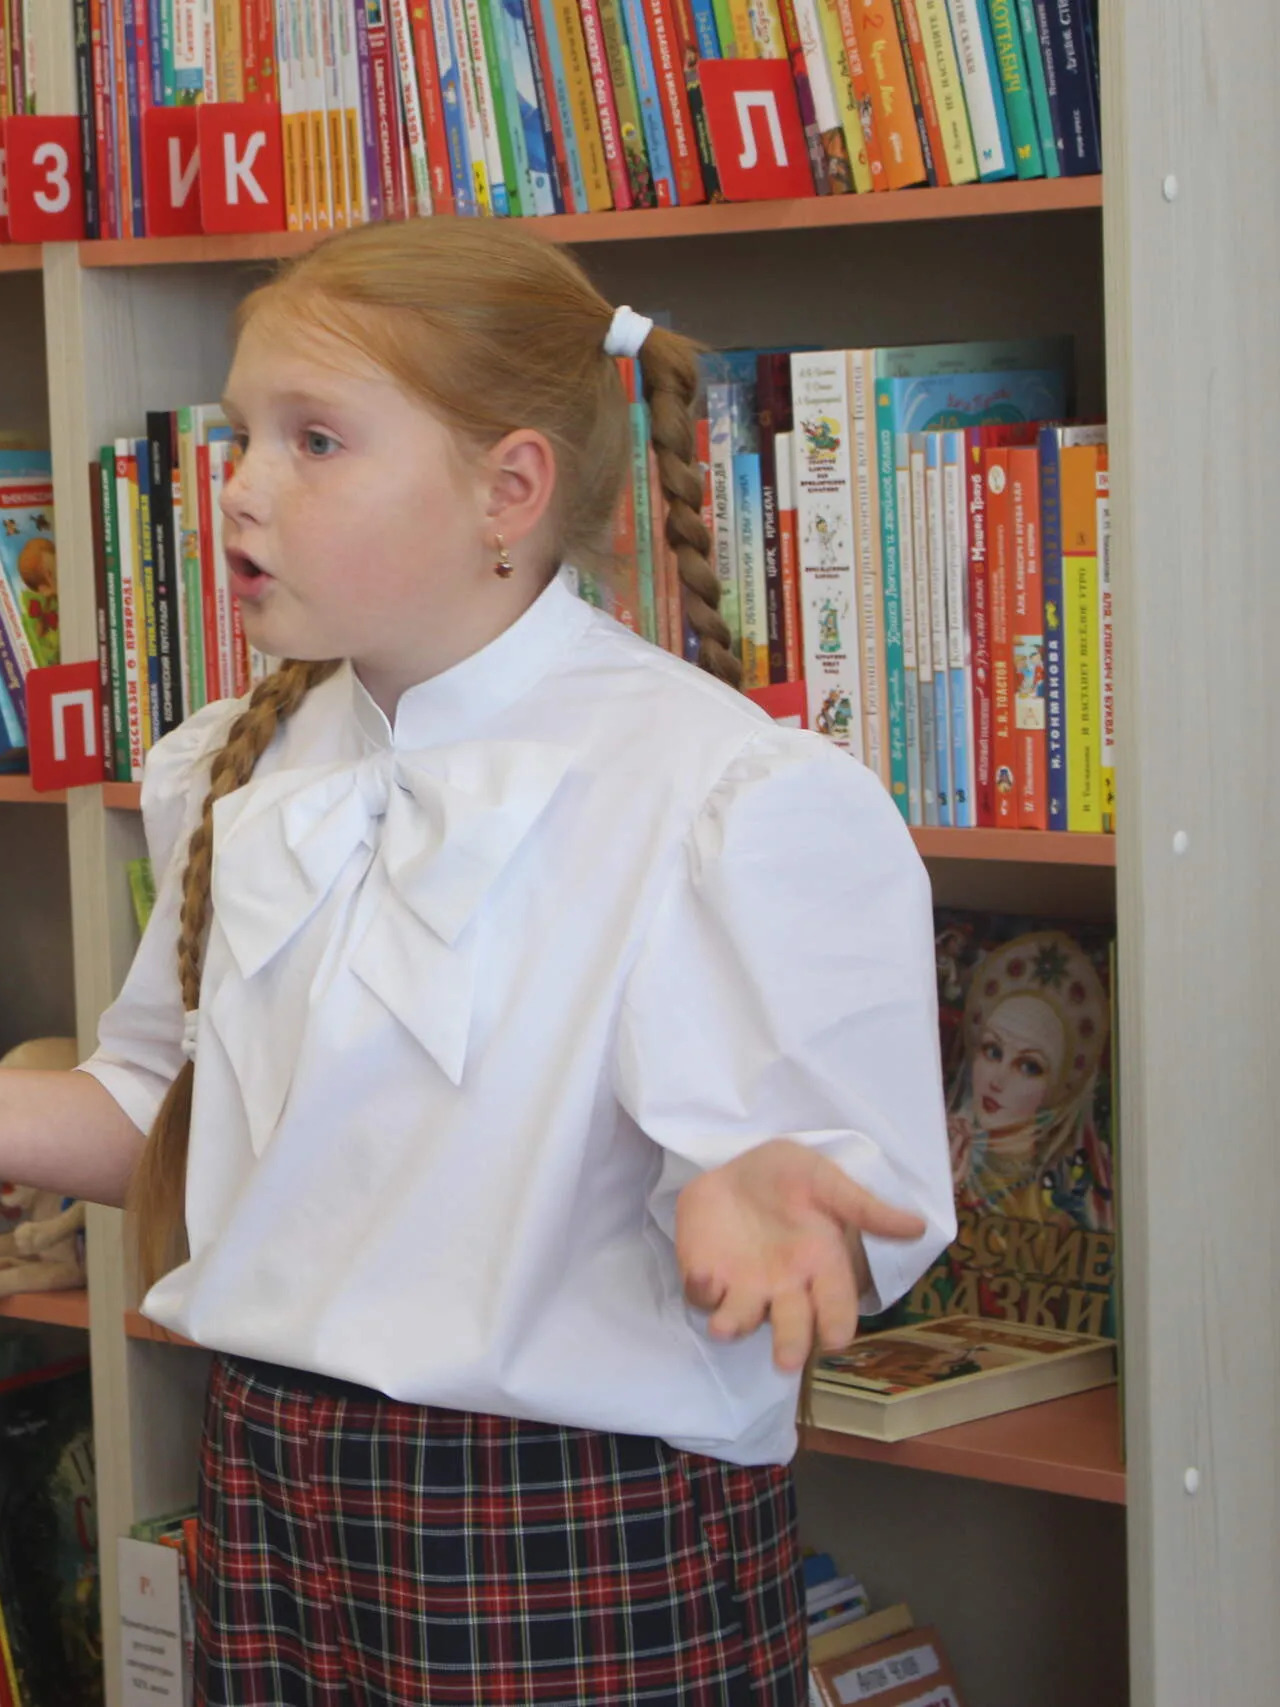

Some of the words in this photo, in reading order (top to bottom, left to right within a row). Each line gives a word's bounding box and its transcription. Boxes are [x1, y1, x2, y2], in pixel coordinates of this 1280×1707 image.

[593, 78, 607, 105] ПРО
[599, 107, 617, 159] СКАЗКА
[733, 90, 788, 169] Л
[32, 142, 71, 213] З
[223, 131, 269, 204] К
[856, 432, 866, 468] кота
[969, 473, 983, 509] Трауб
[971, 511, 985, 560] Машей
[765, 547, 777, 577] ЦИРК
[1103, 623, 1112, 679] КЛЯКСИЧ
[995, 661, 1008, 707] ТОЛСТОЙ
[51, 689, 97, 761] П
[1104, 695, 1113, 736] БУКВА
[954, 1213, 1115, 1289] ССКИЕ
[909, 1267, 1109, 1338] КАЗКИ
